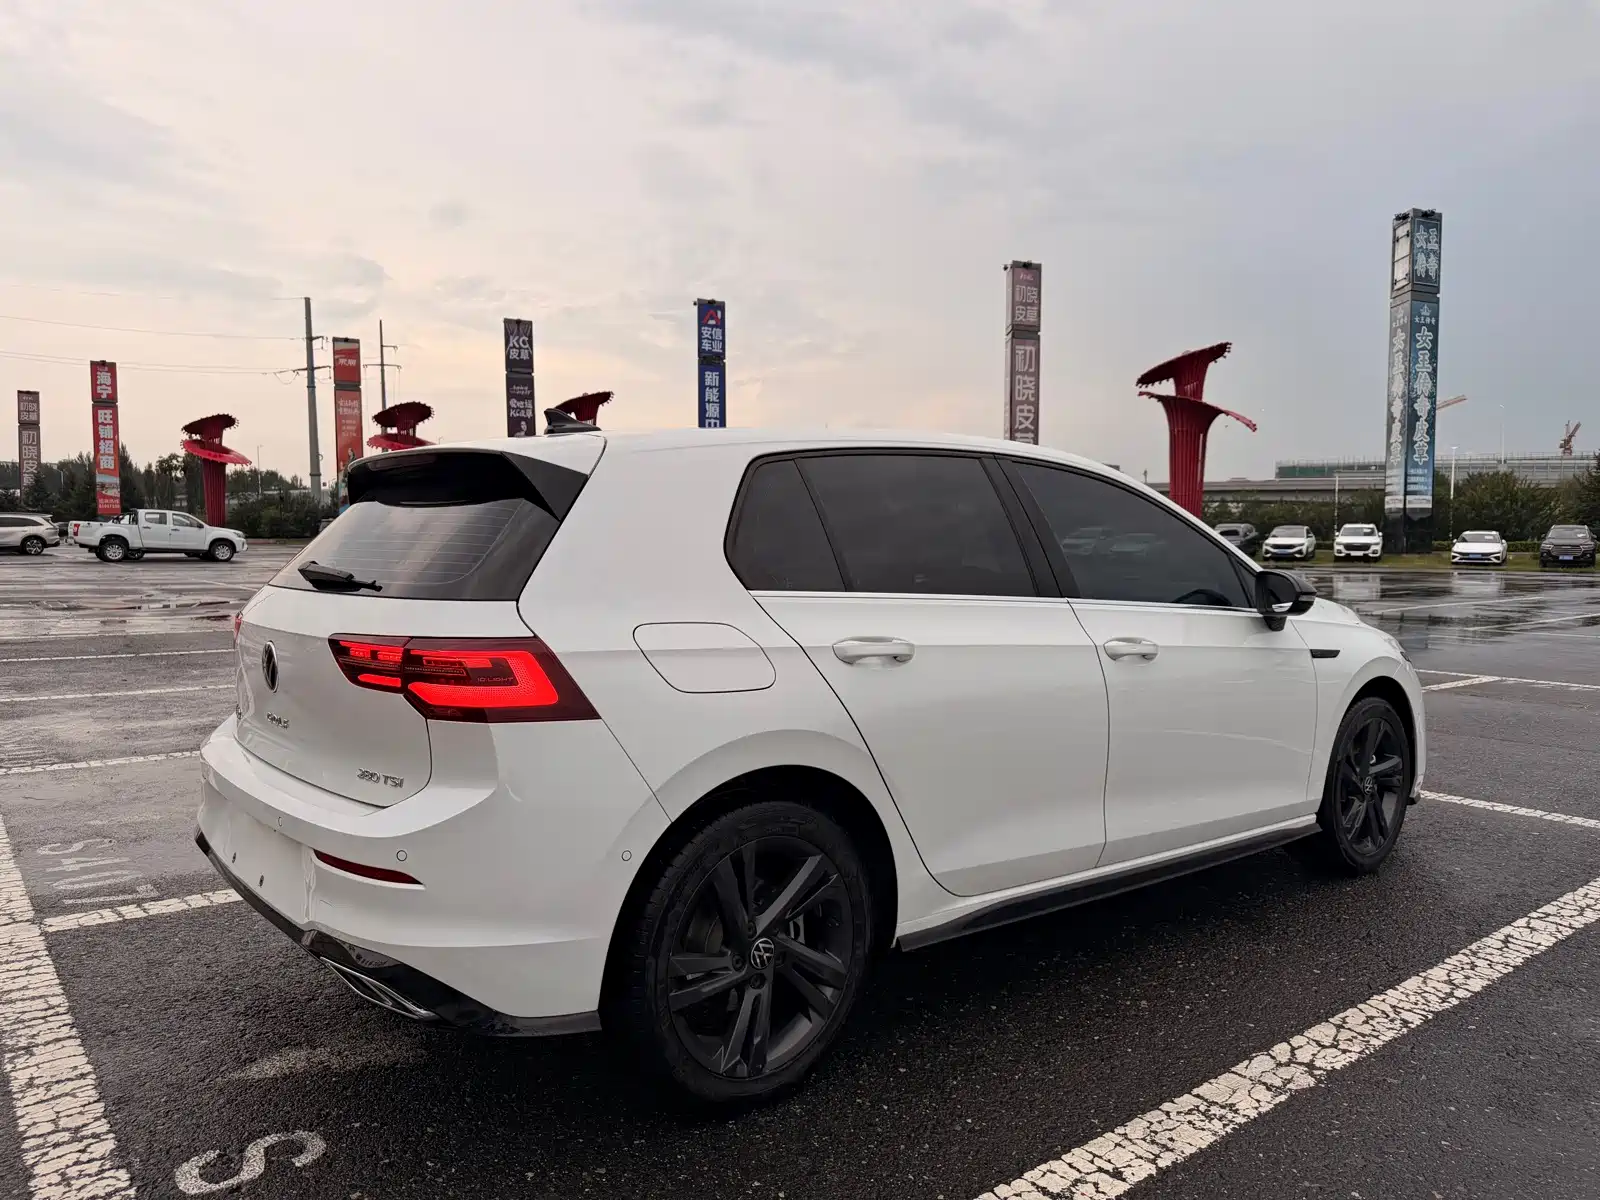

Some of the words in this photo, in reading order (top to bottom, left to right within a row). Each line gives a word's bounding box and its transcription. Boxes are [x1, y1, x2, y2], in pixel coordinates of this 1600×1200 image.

[1415, 225, 1438, 250] 女王
[1015, 285, 1038, 304] 初晓
[509, 335, 529, 349] KC
[701, 326, 722, 341] 安信
[509, 348, 530, 360] 皮草
[701, 340, 723, 353] 车业
[97, 371, 112, 399] 海宁
[1413, 326, 1433, 465] 女王传奇皮草
[98, 409, 115, 470] 旺铺招商
[382, 774, 404, 789] TSI
